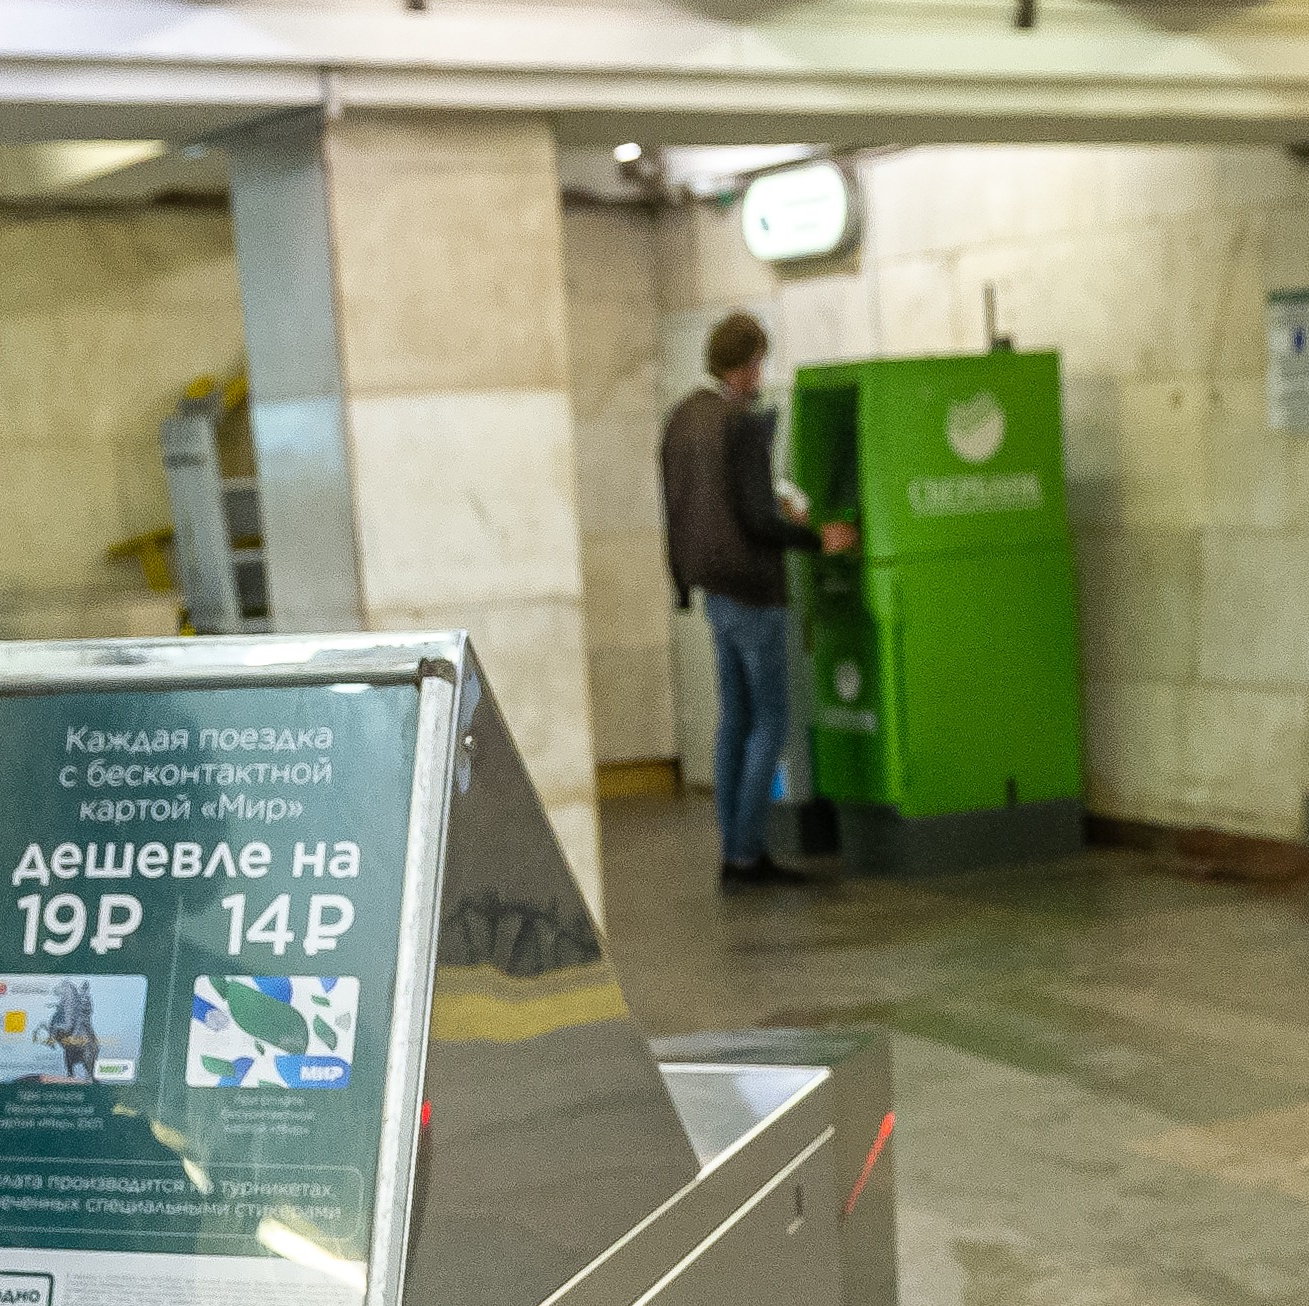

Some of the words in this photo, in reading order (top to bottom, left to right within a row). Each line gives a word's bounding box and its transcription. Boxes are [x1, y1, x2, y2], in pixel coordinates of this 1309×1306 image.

[66, 726, 188, 754] Каждая
[200, 723, 333, 752] поездка
[60, 767, 76, 788] с
[87, 758, 332, 788] бесконтактной
[80, 794, 190, 824] картой
[202, 795, 304, 823] «Мир»
[12, 841, 270, 887] дешевле
[293, 841, 361, 878] на
[18, 893, 143, 956] 19₽
[221, 893, 356, 956] 14₽
